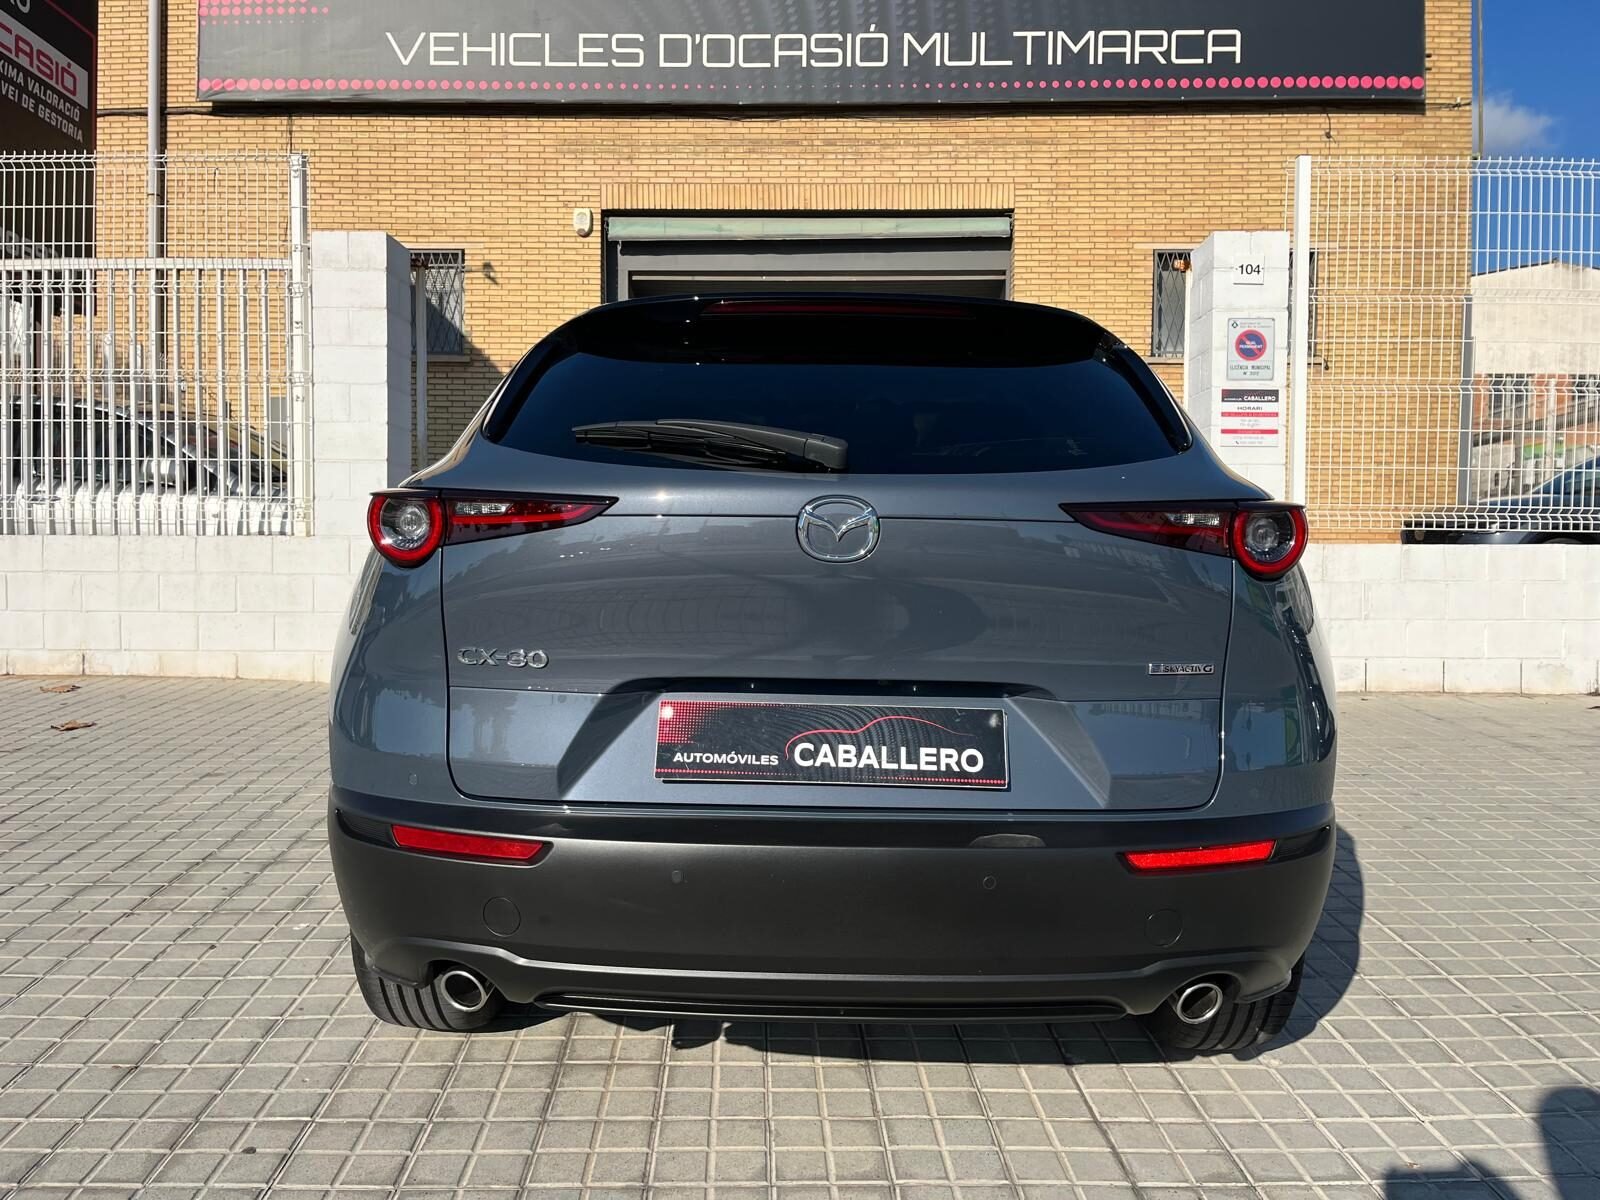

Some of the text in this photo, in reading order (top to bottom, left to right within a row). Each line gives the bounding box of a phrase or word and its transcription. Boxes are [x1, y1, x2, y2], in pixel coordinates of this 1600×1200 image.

[385, 24, 1242, 69] VEHICLES D'OCASIÓ MULTIMARCA
[22, 93, 35, 113] DE
[38, 104, 83, 143] GESTORIA
[27, 76, 80, 122] VALORACIÓ
[1238, 263, 1261, 275] 104
[457, 647, 548, 669] CX-30
[673, 742, 985, 773] AUTOMÓVILES CABALLERO
